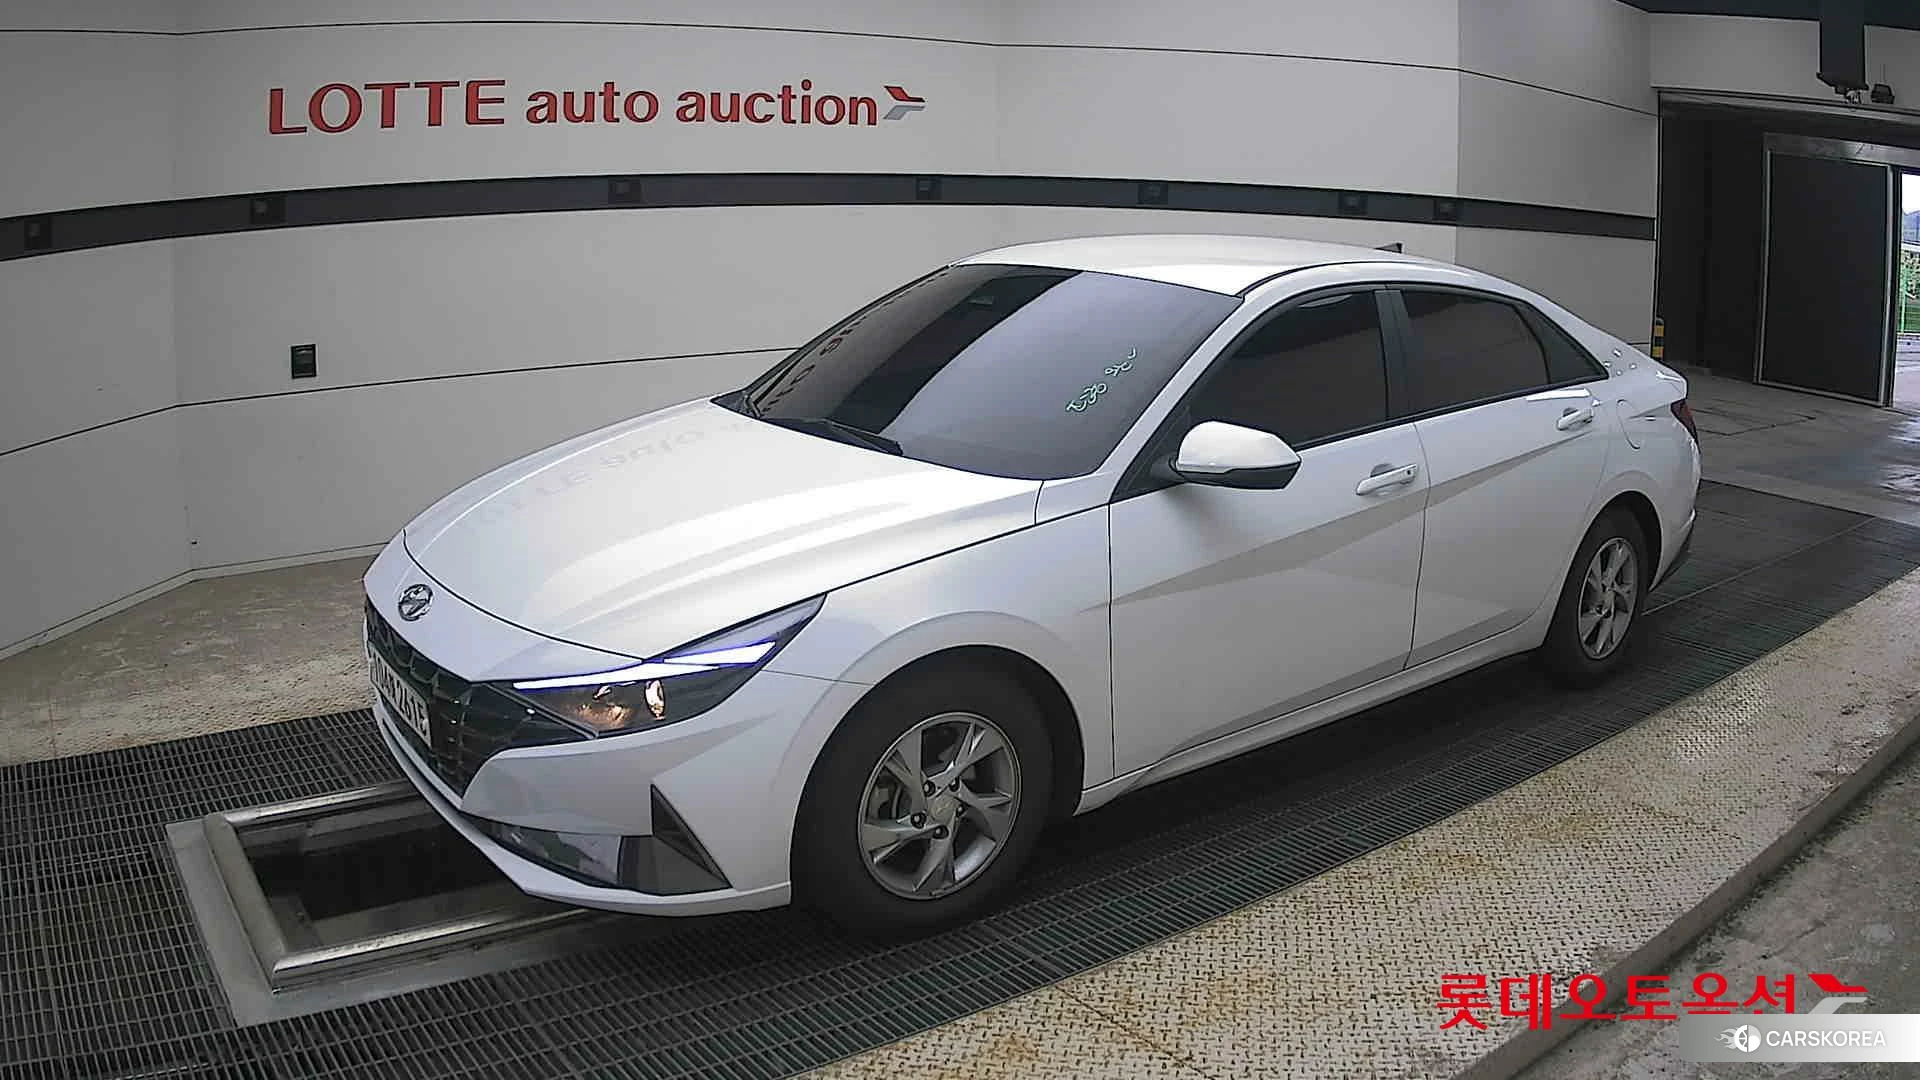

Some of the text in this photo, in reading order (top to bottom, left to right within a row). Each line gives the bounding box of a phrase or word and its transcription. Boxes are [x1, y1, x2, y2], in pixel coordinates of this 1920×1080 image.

[269, 79, 877, 134] LOTTE auto auction
